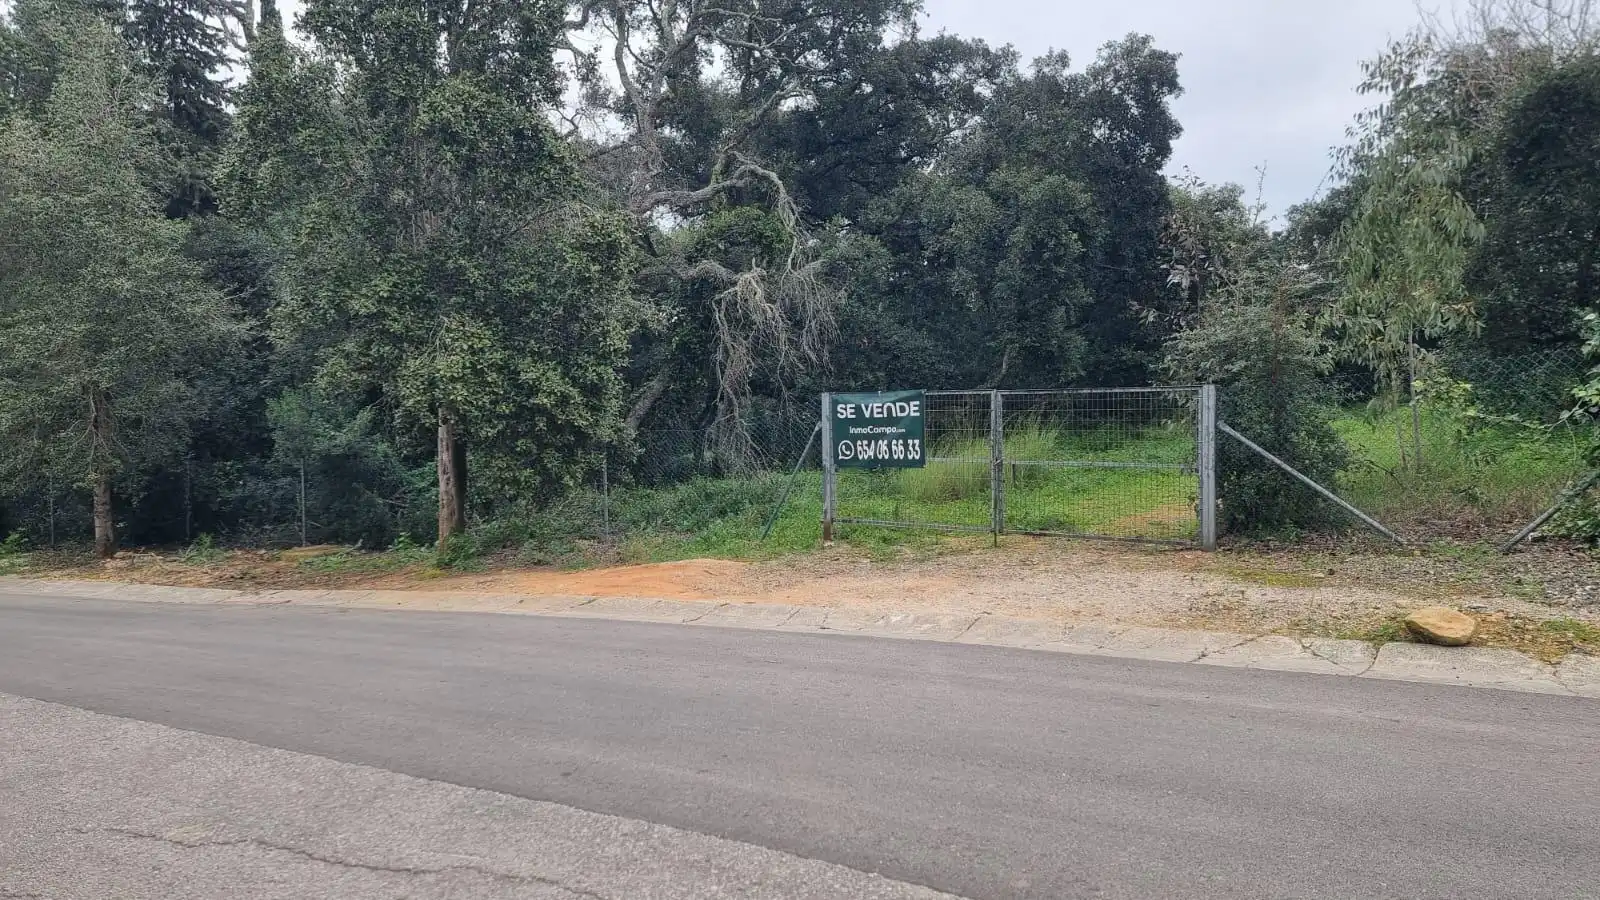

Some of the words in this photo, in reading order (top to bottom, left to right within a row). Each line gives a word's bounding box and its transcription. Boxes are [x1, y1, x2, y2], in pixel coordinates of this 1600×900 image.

[837, 404, 856, 418] SE
[861, 401, 920, 418] VENDE
[857, 440, 875, 460] 654
[877, 440, 889, 460] 06
[892, 439, 905, 460] 66
[907, 439, 920, 460] 33
